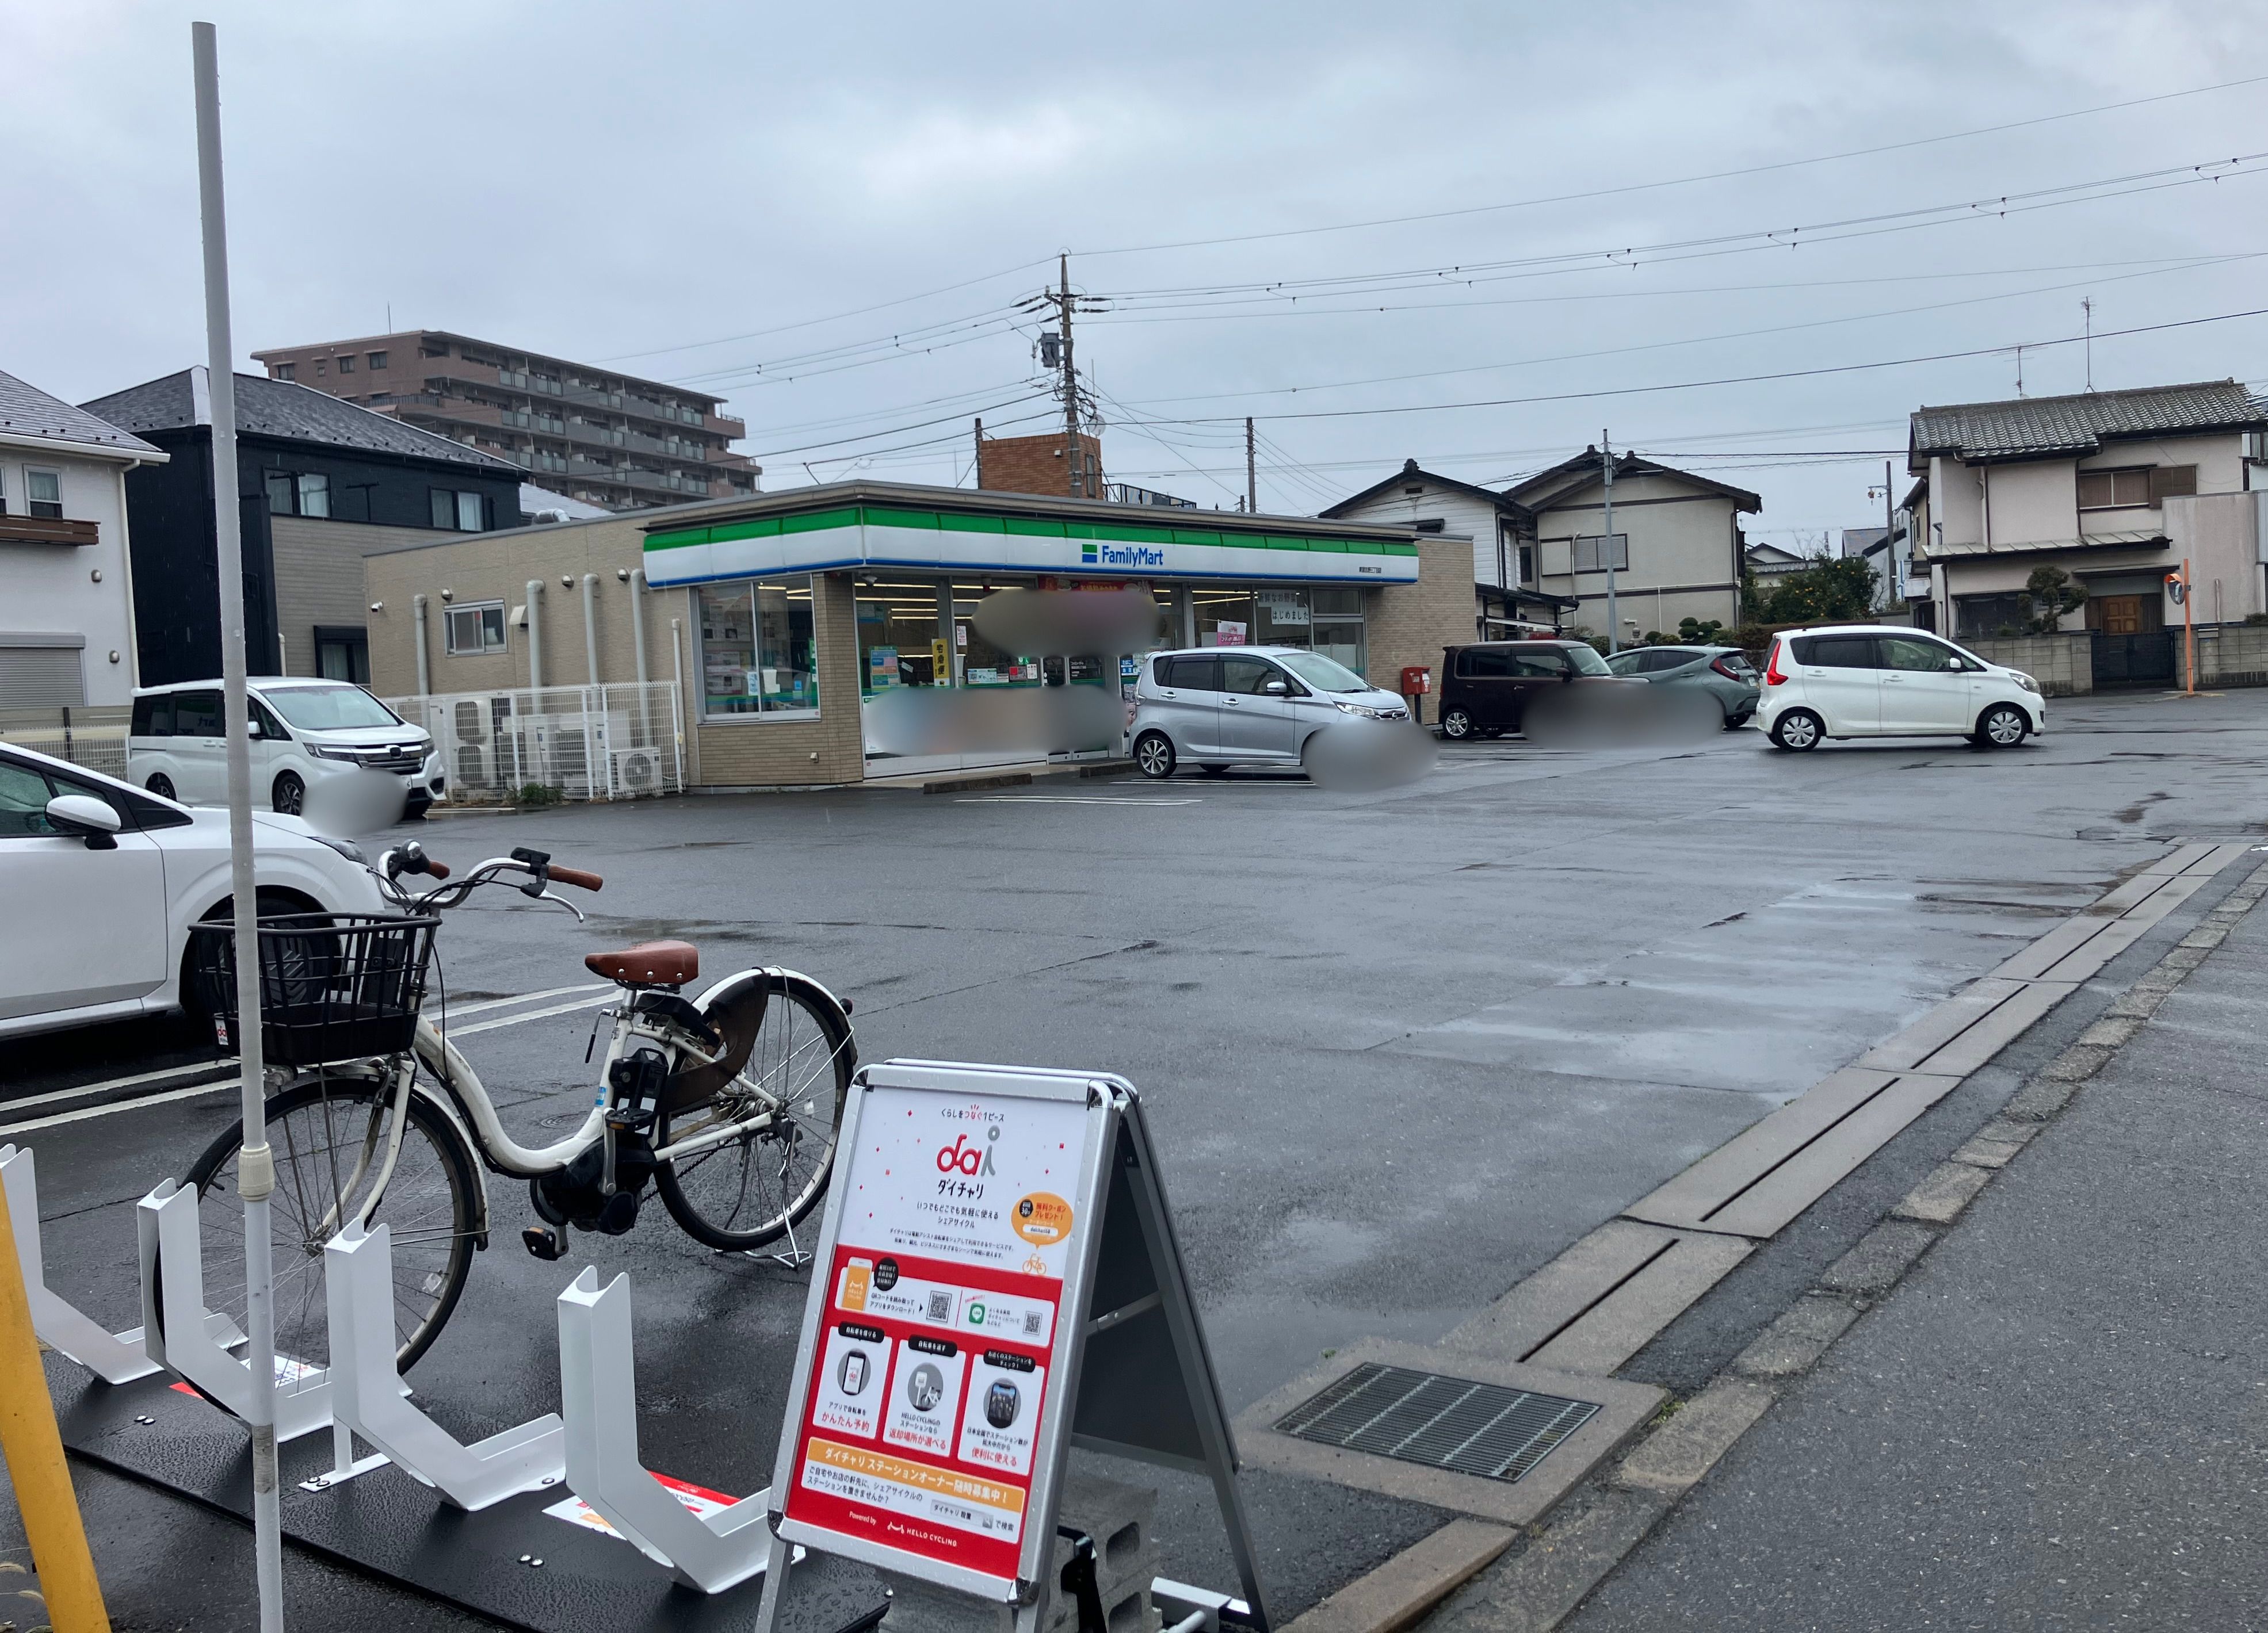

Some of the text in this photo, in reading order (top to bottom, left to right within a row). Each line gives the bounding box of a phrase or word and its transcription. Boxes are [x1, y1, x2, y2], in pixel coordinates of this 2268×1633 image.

[1102, 545, 1163, 567] FamilyMart
[1272, 610, 1309, 620] はじめました
[937, 644, 945, 675] 宅急便
[941, 1108, 1005, 1122] くらしをつなぐ1ピース
[937, 1125, 1001, 1177] dai
[938, 1179, 984, 1199] ダイチャリ
[917, 1200, 999, 1219] いつでもどこでも気軽に使える
[937, 1216, 975, 1229] シェアサイクル
[871, 1292, 915, 1306] QRコードを読み取って
[869, 1301, 915, 1315] アプリをダウンロード！
[846, 1326, 877, 1338] 自転車を借りる
[918, 1340, 946, 1352] 自転車を返す
[988, 1351, 1032, 1366] お近くのステーションを
[828, 1401, 867, 1416] アプリで自転車を
[821, 1411, 870, 1432] かんたん予約
[900, 1420, 938, 1435] ステーションなら
[901, 1412, 941, 1427] HELLO CYCLINGの
[888, 1428, 946, 1450] 返却場所が選べる
[967, 1427, 1029, 1446] 日本全国でステーション数が
[982, 1439, 1011, 1451] 拡大中だから
[972, 1447, 1017, 1467] 便利に使える
[807, 1475, 889, 1504] ステーションを置きませんか？
[810, 1466, 923, 1501] ご自宅やお店の軒先に、シェアサイクルの
[849, 1510, 877, 1526] Powered by
[934, 1504, 959, 1516] ダイチャリ
[995, 1520, 1014, 1532] で検索
[907, 1528, 957, 1547] HELLO CYCLING
